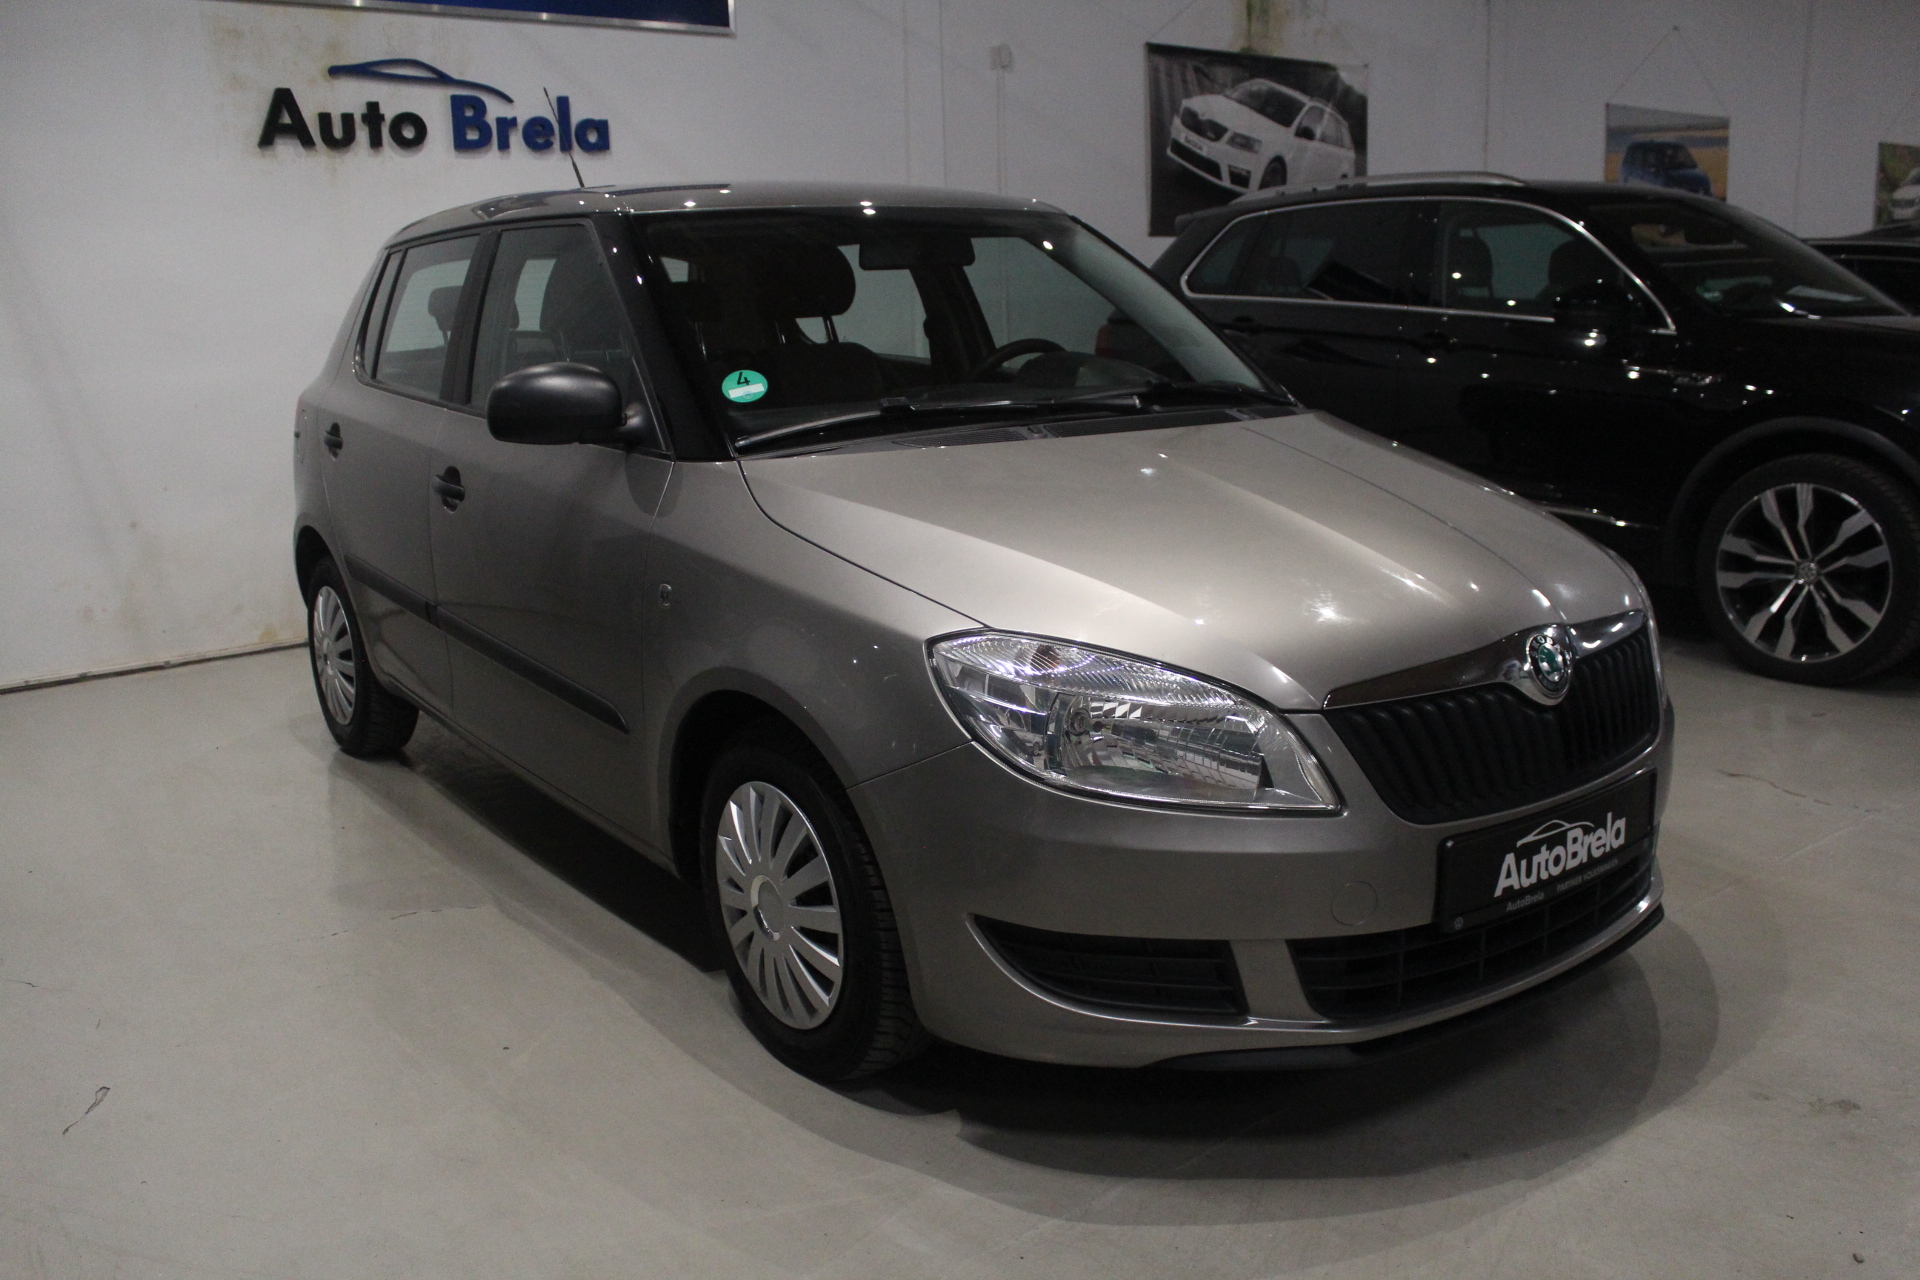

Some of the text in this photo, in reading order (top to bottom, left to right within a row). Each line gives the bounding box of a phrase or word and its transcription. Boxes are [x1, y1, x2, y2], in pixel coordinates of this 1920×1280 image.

[258, 88, 610, 152] Auto Brela
[737, 371, 750, 385] 4
[1494, 812, 1626, 898] AutoBrela
